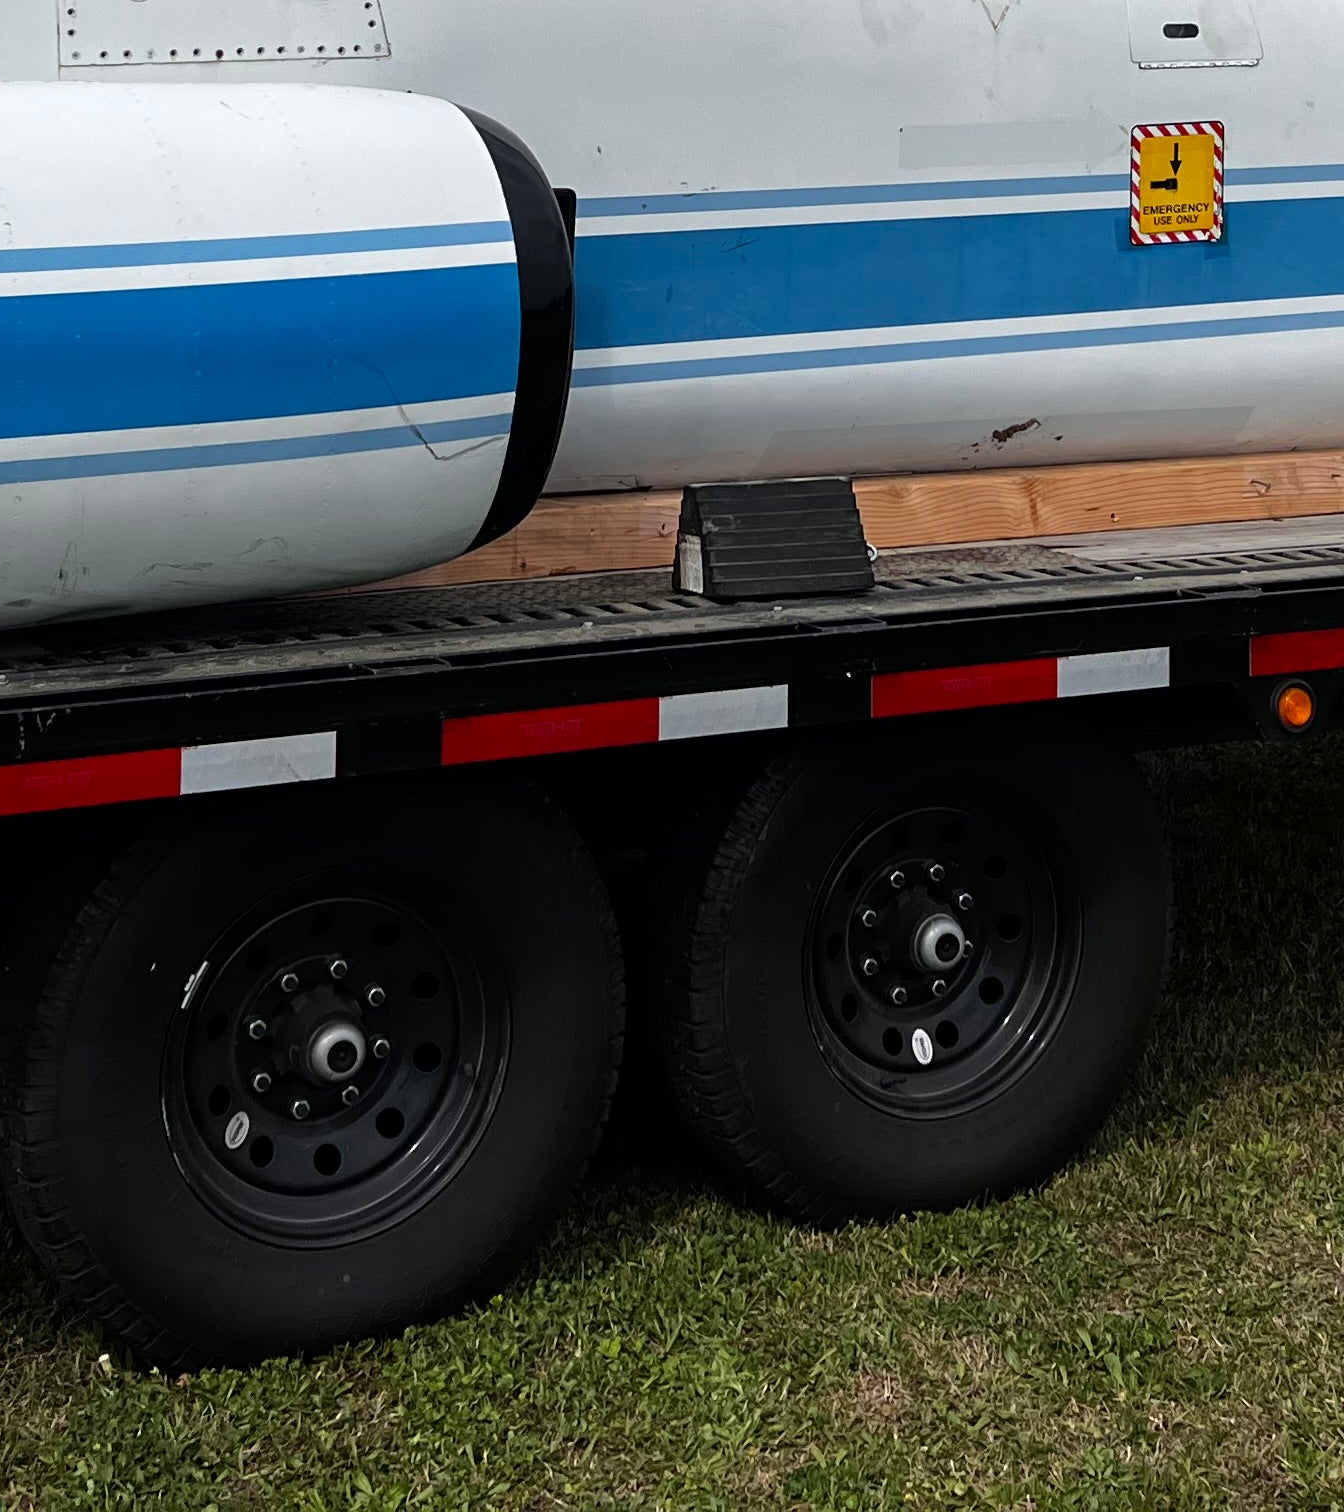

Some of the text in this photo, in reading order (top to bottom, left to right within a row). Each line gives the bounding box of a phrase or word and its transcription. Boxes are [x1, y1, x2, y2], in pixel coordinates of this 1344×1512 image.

[1143, 203, 1210, 215] EMERGENCY
[1153, 215, 1199, 225] USE ONLY
